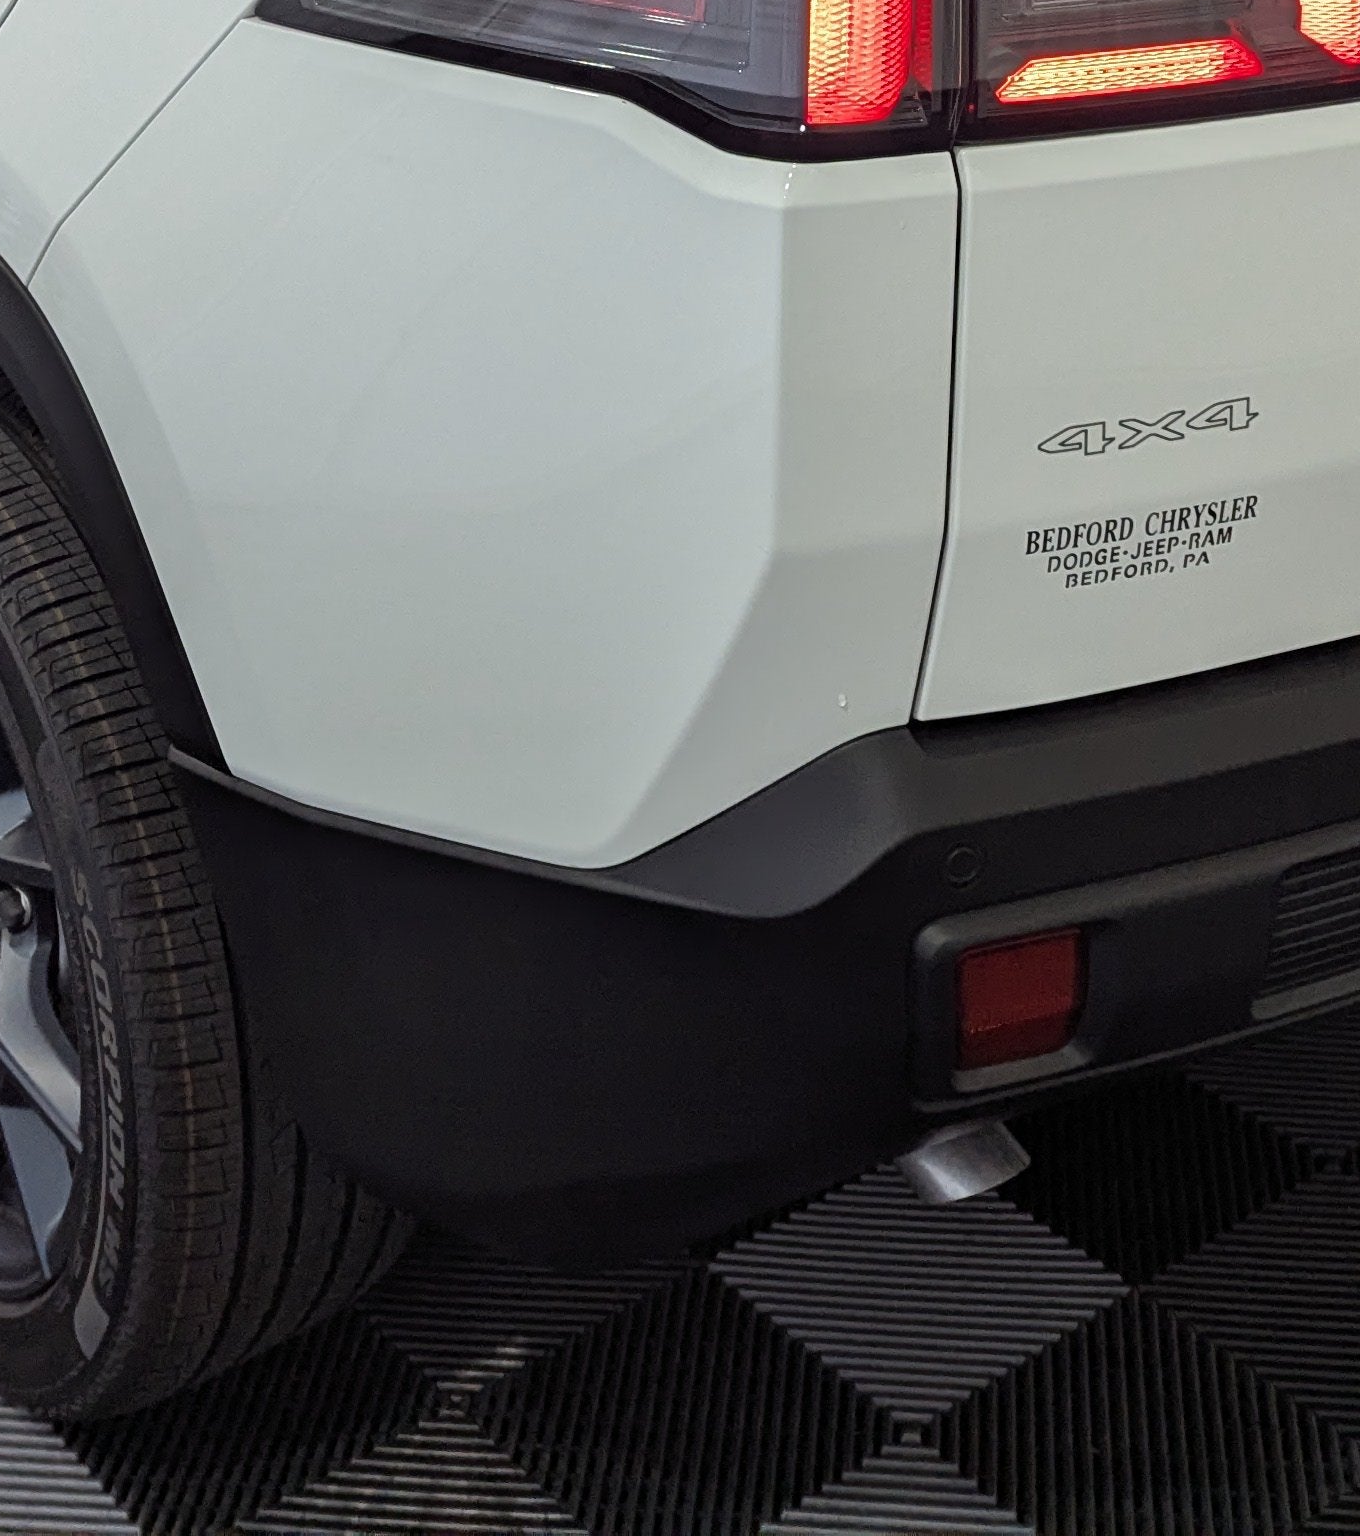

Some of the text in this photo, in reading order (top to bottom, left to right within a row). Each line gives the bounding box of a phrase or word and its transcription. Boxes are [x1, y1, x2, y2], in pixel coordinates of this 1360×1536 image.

[1026, 495, 1259, 555] BEDFORD CHRYSLER
[1065, 551, 1211, 589] BEDFORD, PA
[74, 867, 125, 1210] SCORPION
